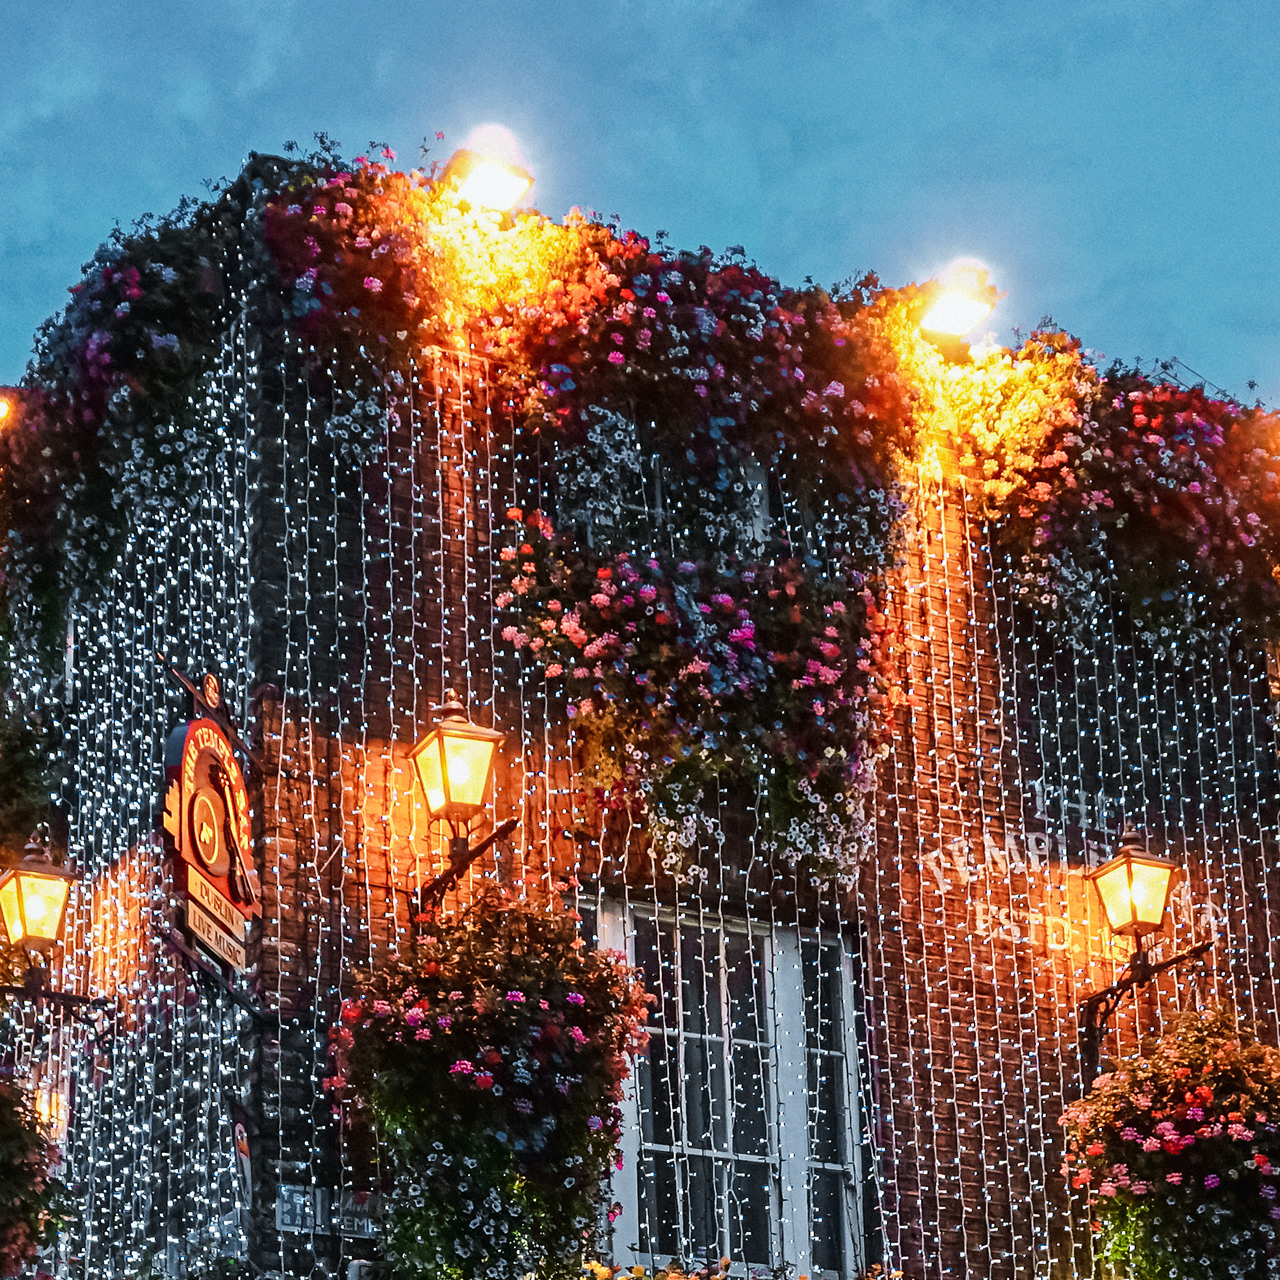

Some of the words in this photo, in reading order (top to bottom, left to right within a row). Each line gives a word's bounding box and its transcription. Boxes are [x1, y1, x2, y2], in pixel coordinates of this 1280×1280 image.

[199, 880, 235, 927] DUBLIN
[192, 909, 213, 943] LIVE
[214, 931, 242, 967] MUSIC
